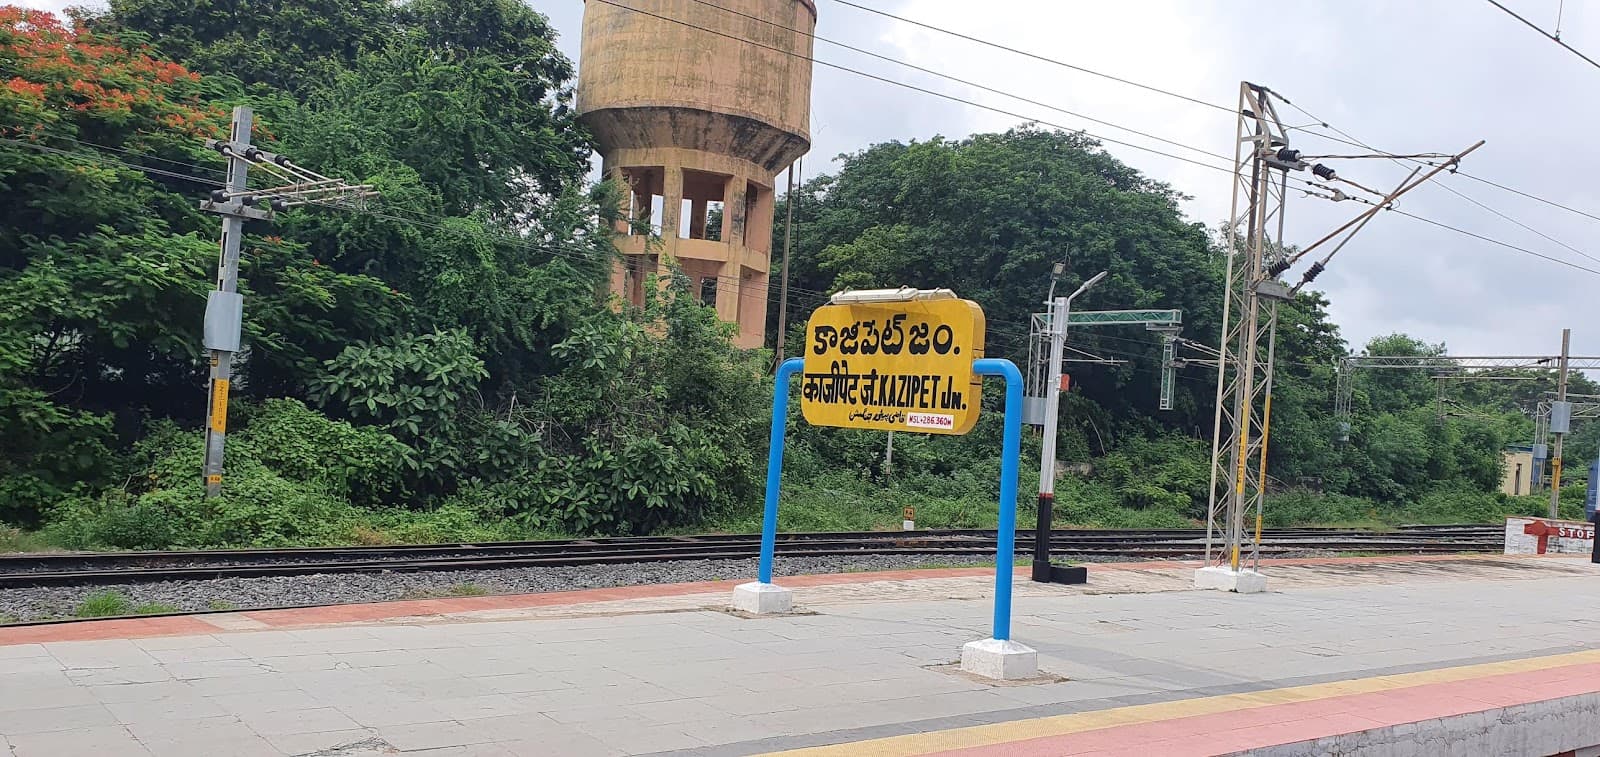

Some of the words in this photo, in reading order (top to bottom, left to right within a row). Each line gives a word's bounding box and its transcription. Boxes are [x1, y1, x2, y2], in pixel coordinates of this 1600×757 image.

[804, 360, 860, 405] काजीपेट
[878, 375, 940, 409] KAZIPET
[1559, 528, 1595, 539] STOP
